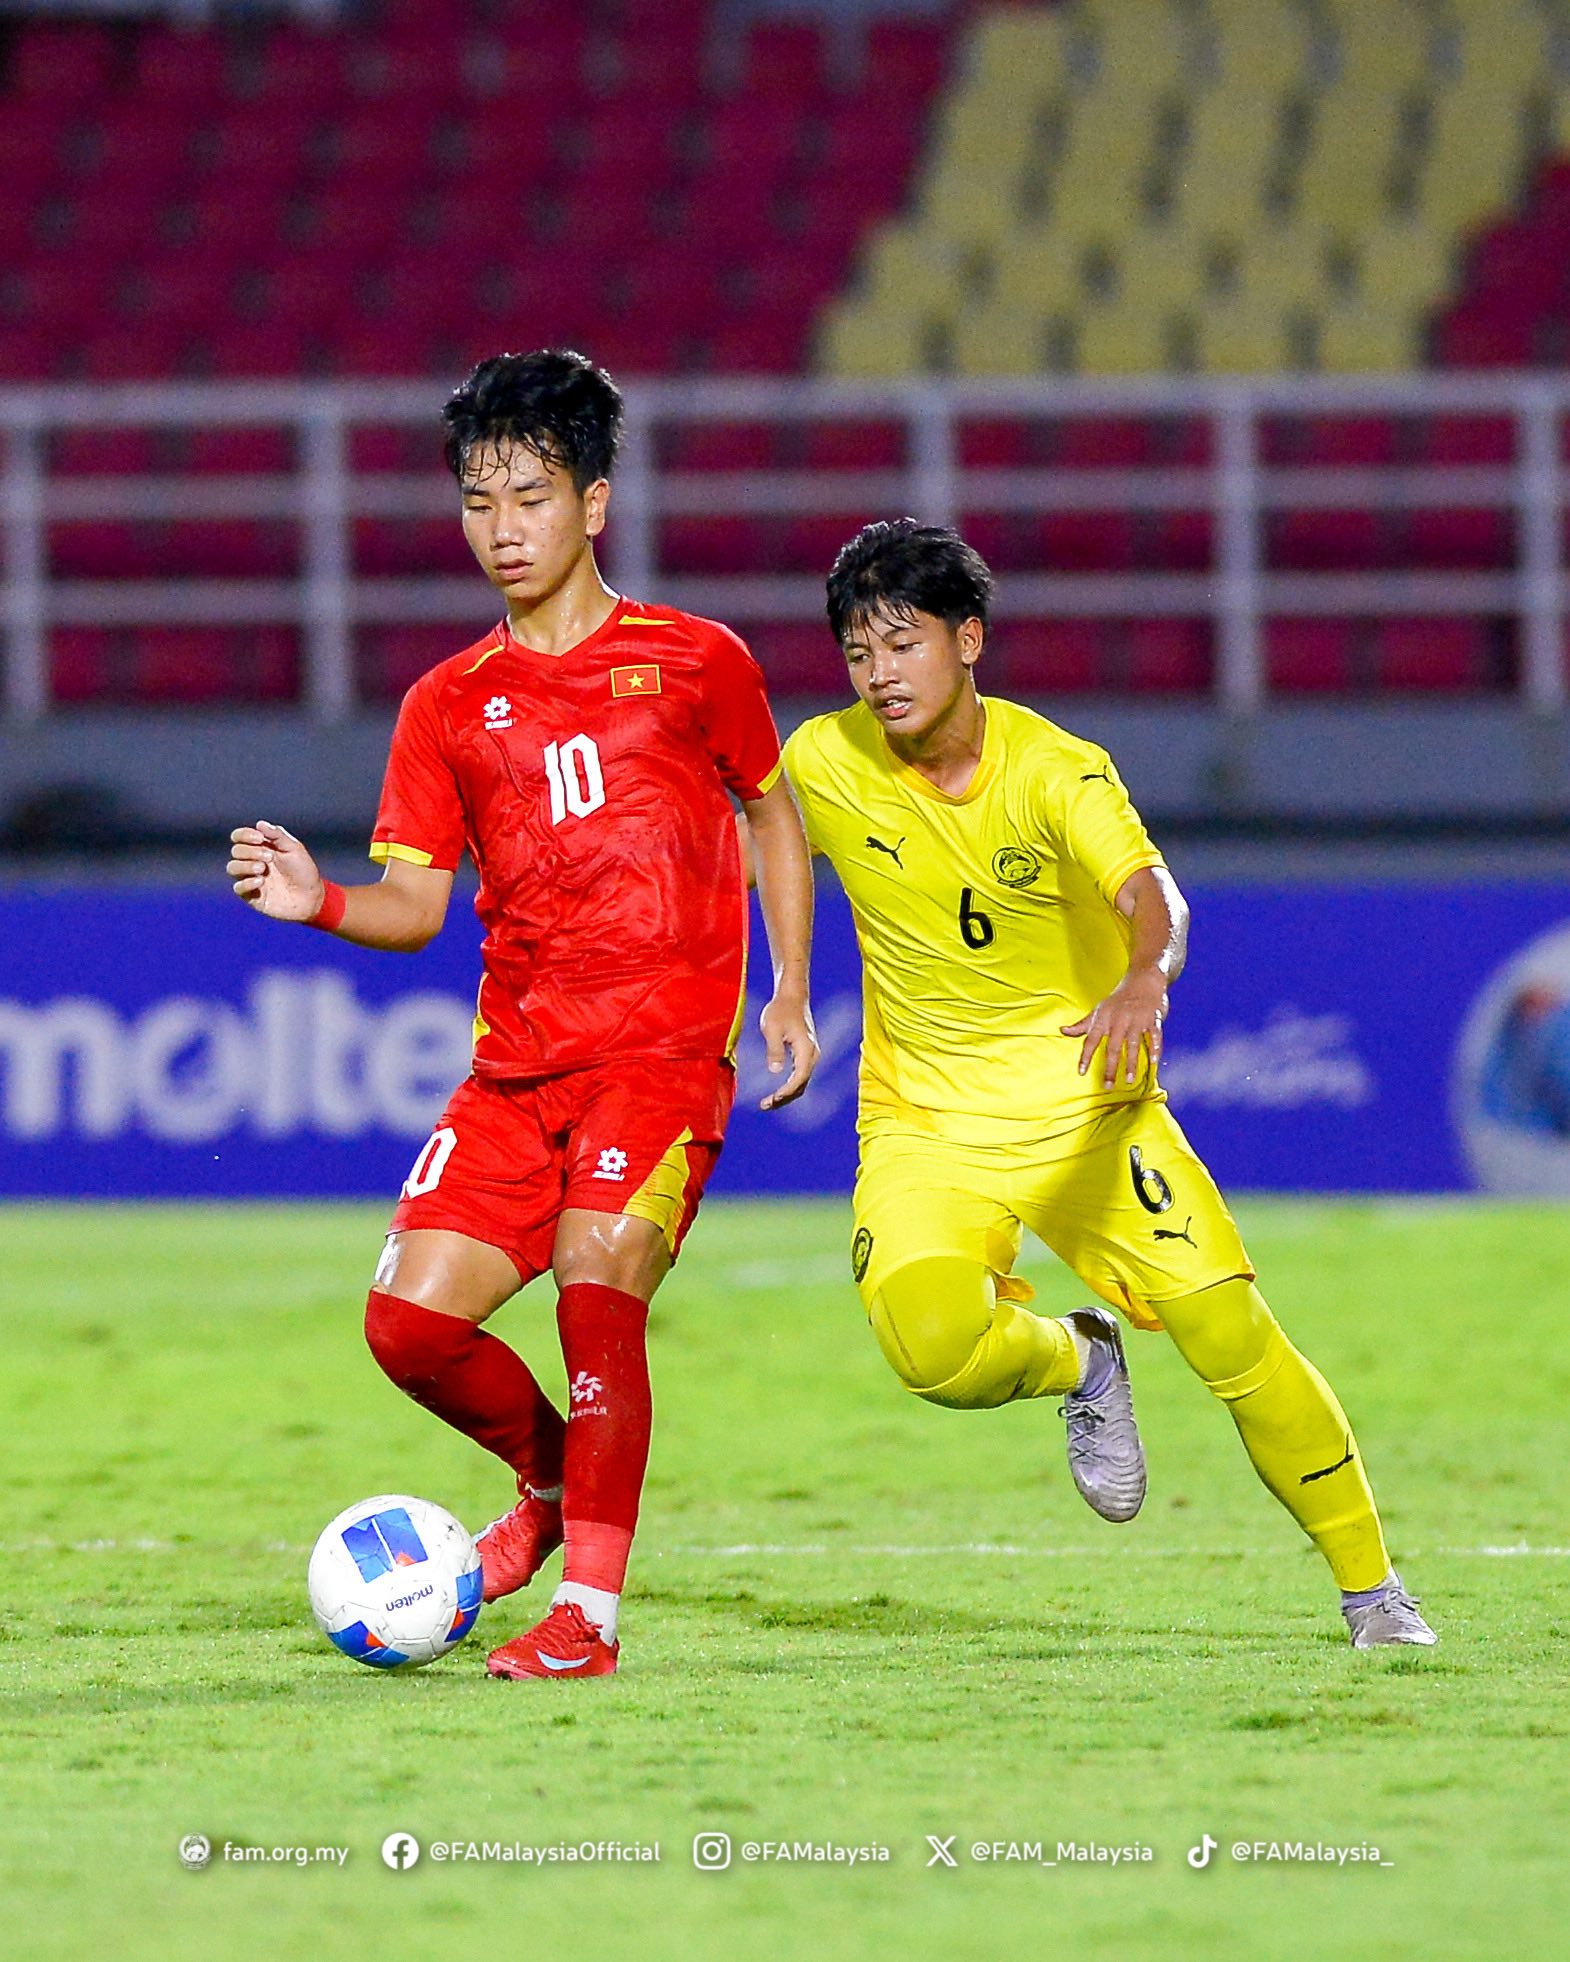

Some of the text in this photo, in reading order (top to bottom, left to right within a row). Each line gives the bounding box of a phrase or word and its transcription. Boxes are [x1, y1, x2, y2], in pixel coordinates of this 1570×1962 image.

[543, 732, 606, 827] 10
[959, 887, 995, 950] 6
[399, 1126, 458, 1200] 0
[1129, 1144, 1174, 1214] 6
[385, 1584, 434, 1612] molten
